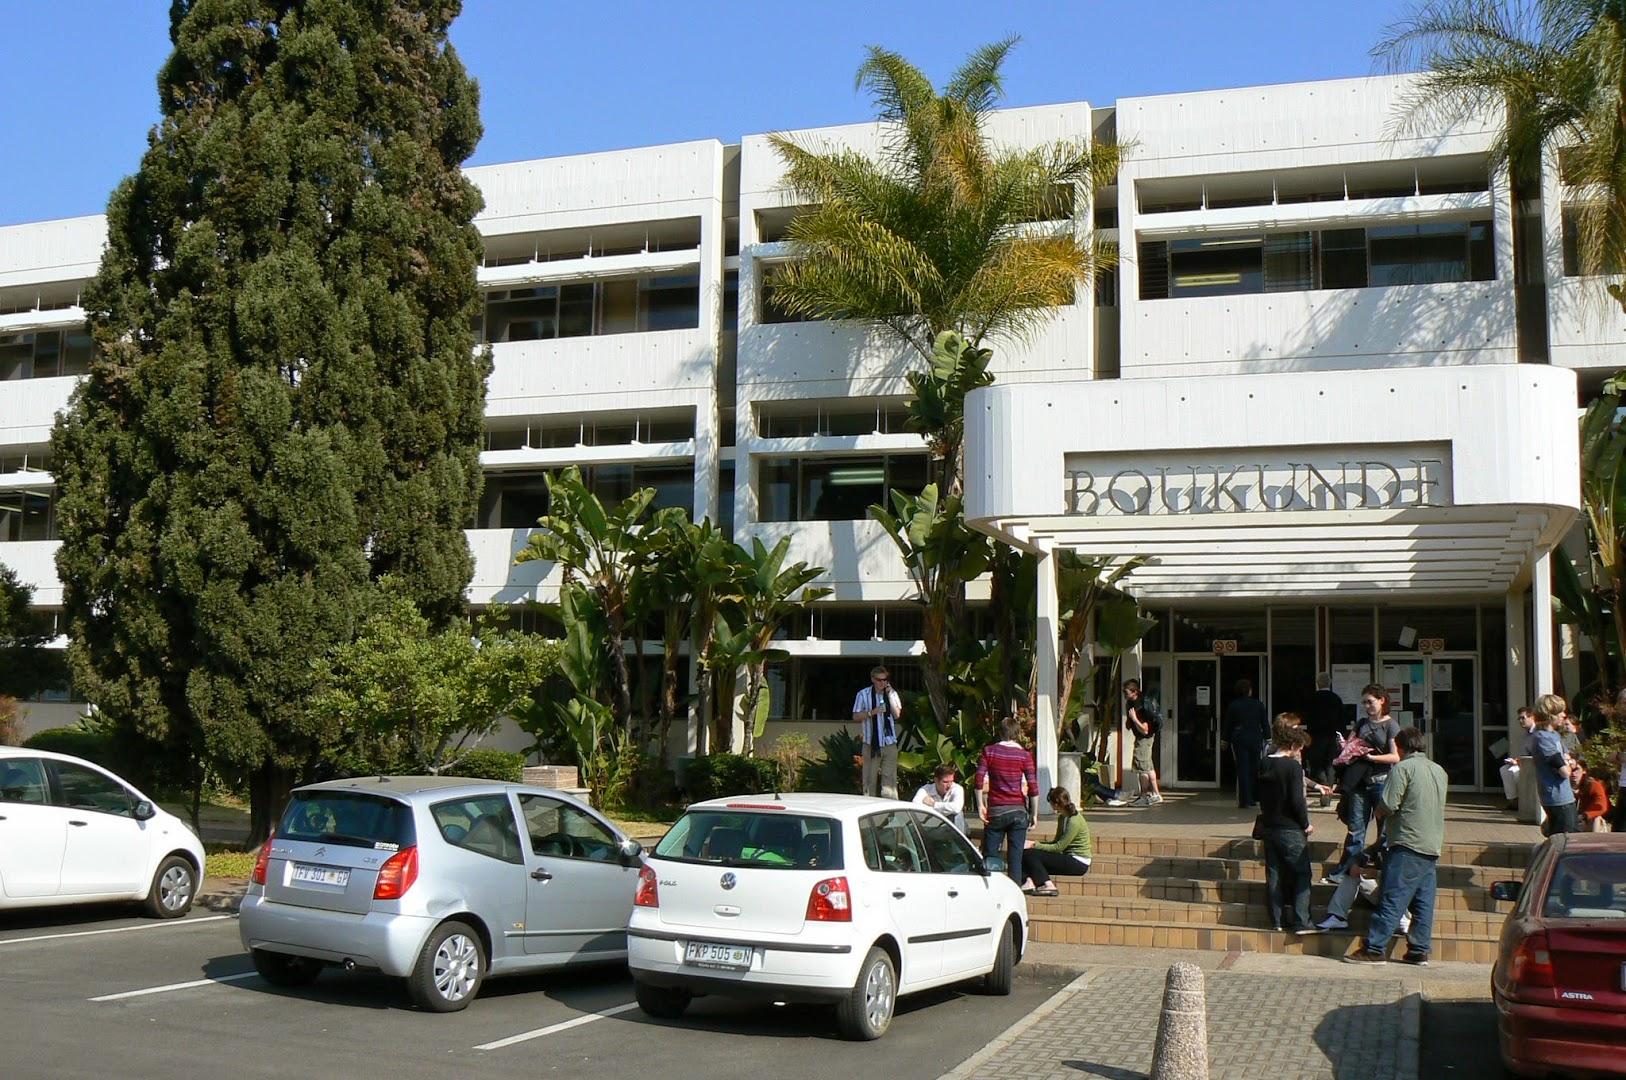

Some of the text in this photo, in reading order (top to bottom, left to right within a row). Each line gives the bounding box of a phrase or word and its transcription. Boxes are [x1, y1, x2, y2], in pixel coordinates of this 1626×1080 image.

[1066, 459, 1444, 515] BOUKUNDE
[688, 943, 753, 963] FKP 505 N
[1561, 991, 1594, 1001] ASTRA
